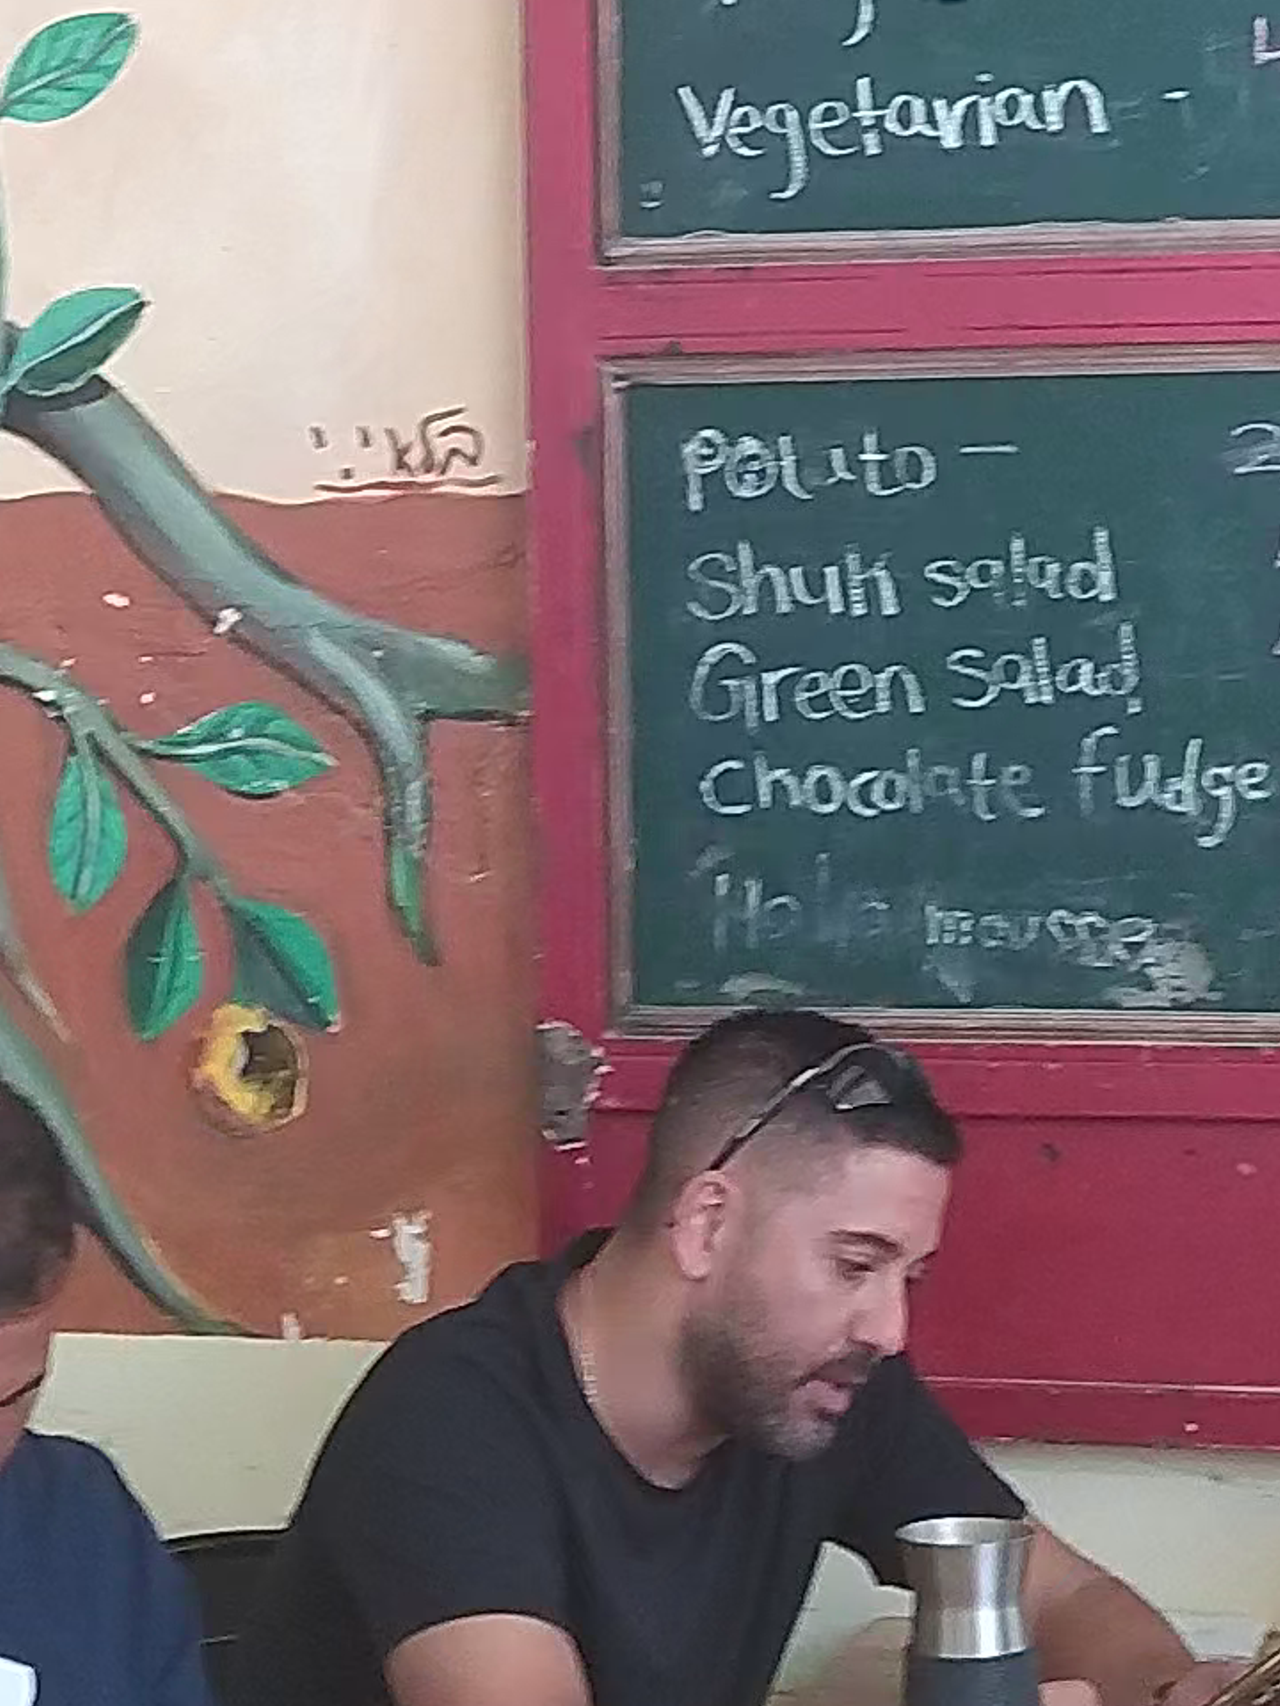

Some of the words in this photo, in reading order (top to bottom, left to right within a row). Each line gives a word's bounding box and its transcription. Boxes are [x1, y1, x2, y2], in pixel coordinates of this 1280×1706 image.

[676, 71, 1111, 200] Vegetarian
[923, 525, 1120, 607] salad
[686, 641, 927, 734] Green
[698, 748, 1047, 822] Chocolate
[1071, 724, 1274, 849] fudge
